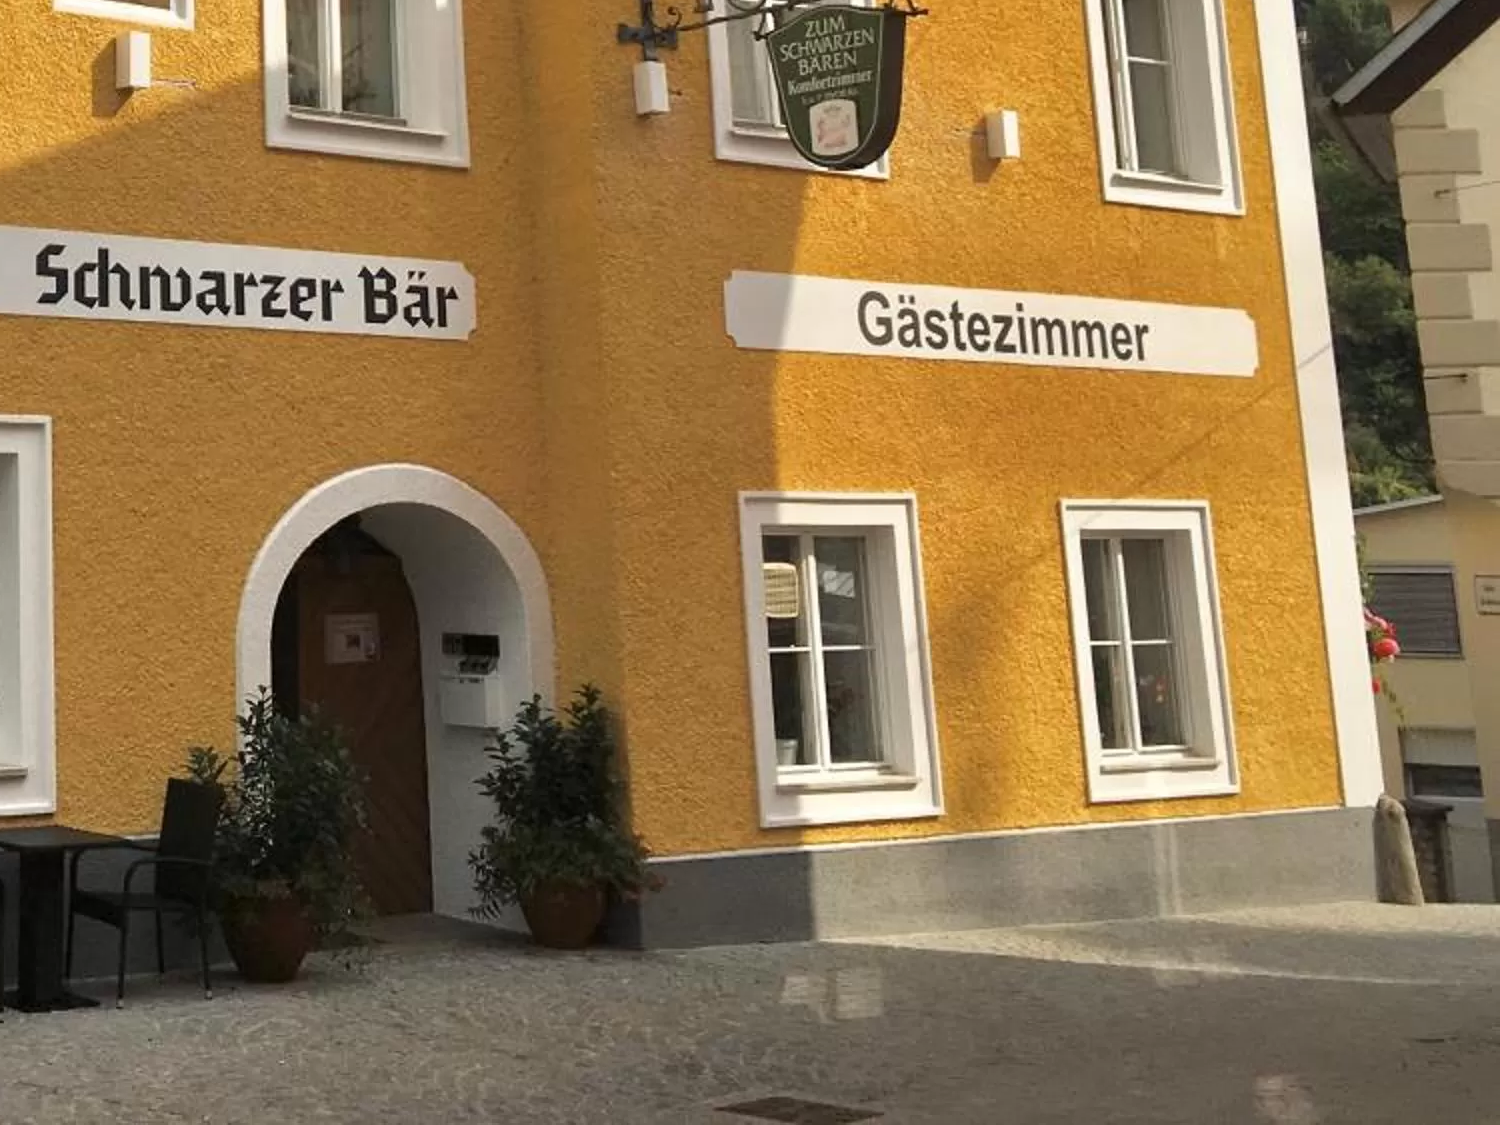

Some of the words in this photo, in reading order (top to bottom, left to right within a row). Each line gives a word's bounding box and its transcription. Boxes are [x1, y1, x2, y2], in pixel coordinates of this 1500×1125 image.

[779, 26, 875, 63] SCHWARZEN
[804, 14, 846, 38] ZUM
[798, 49, 858, 76] BÄREN
[35, 243, 345, 323] Schwarzer
[357, 265, 460, 329] Bär
[857, 290, 1149, 362] Gästezimmer
